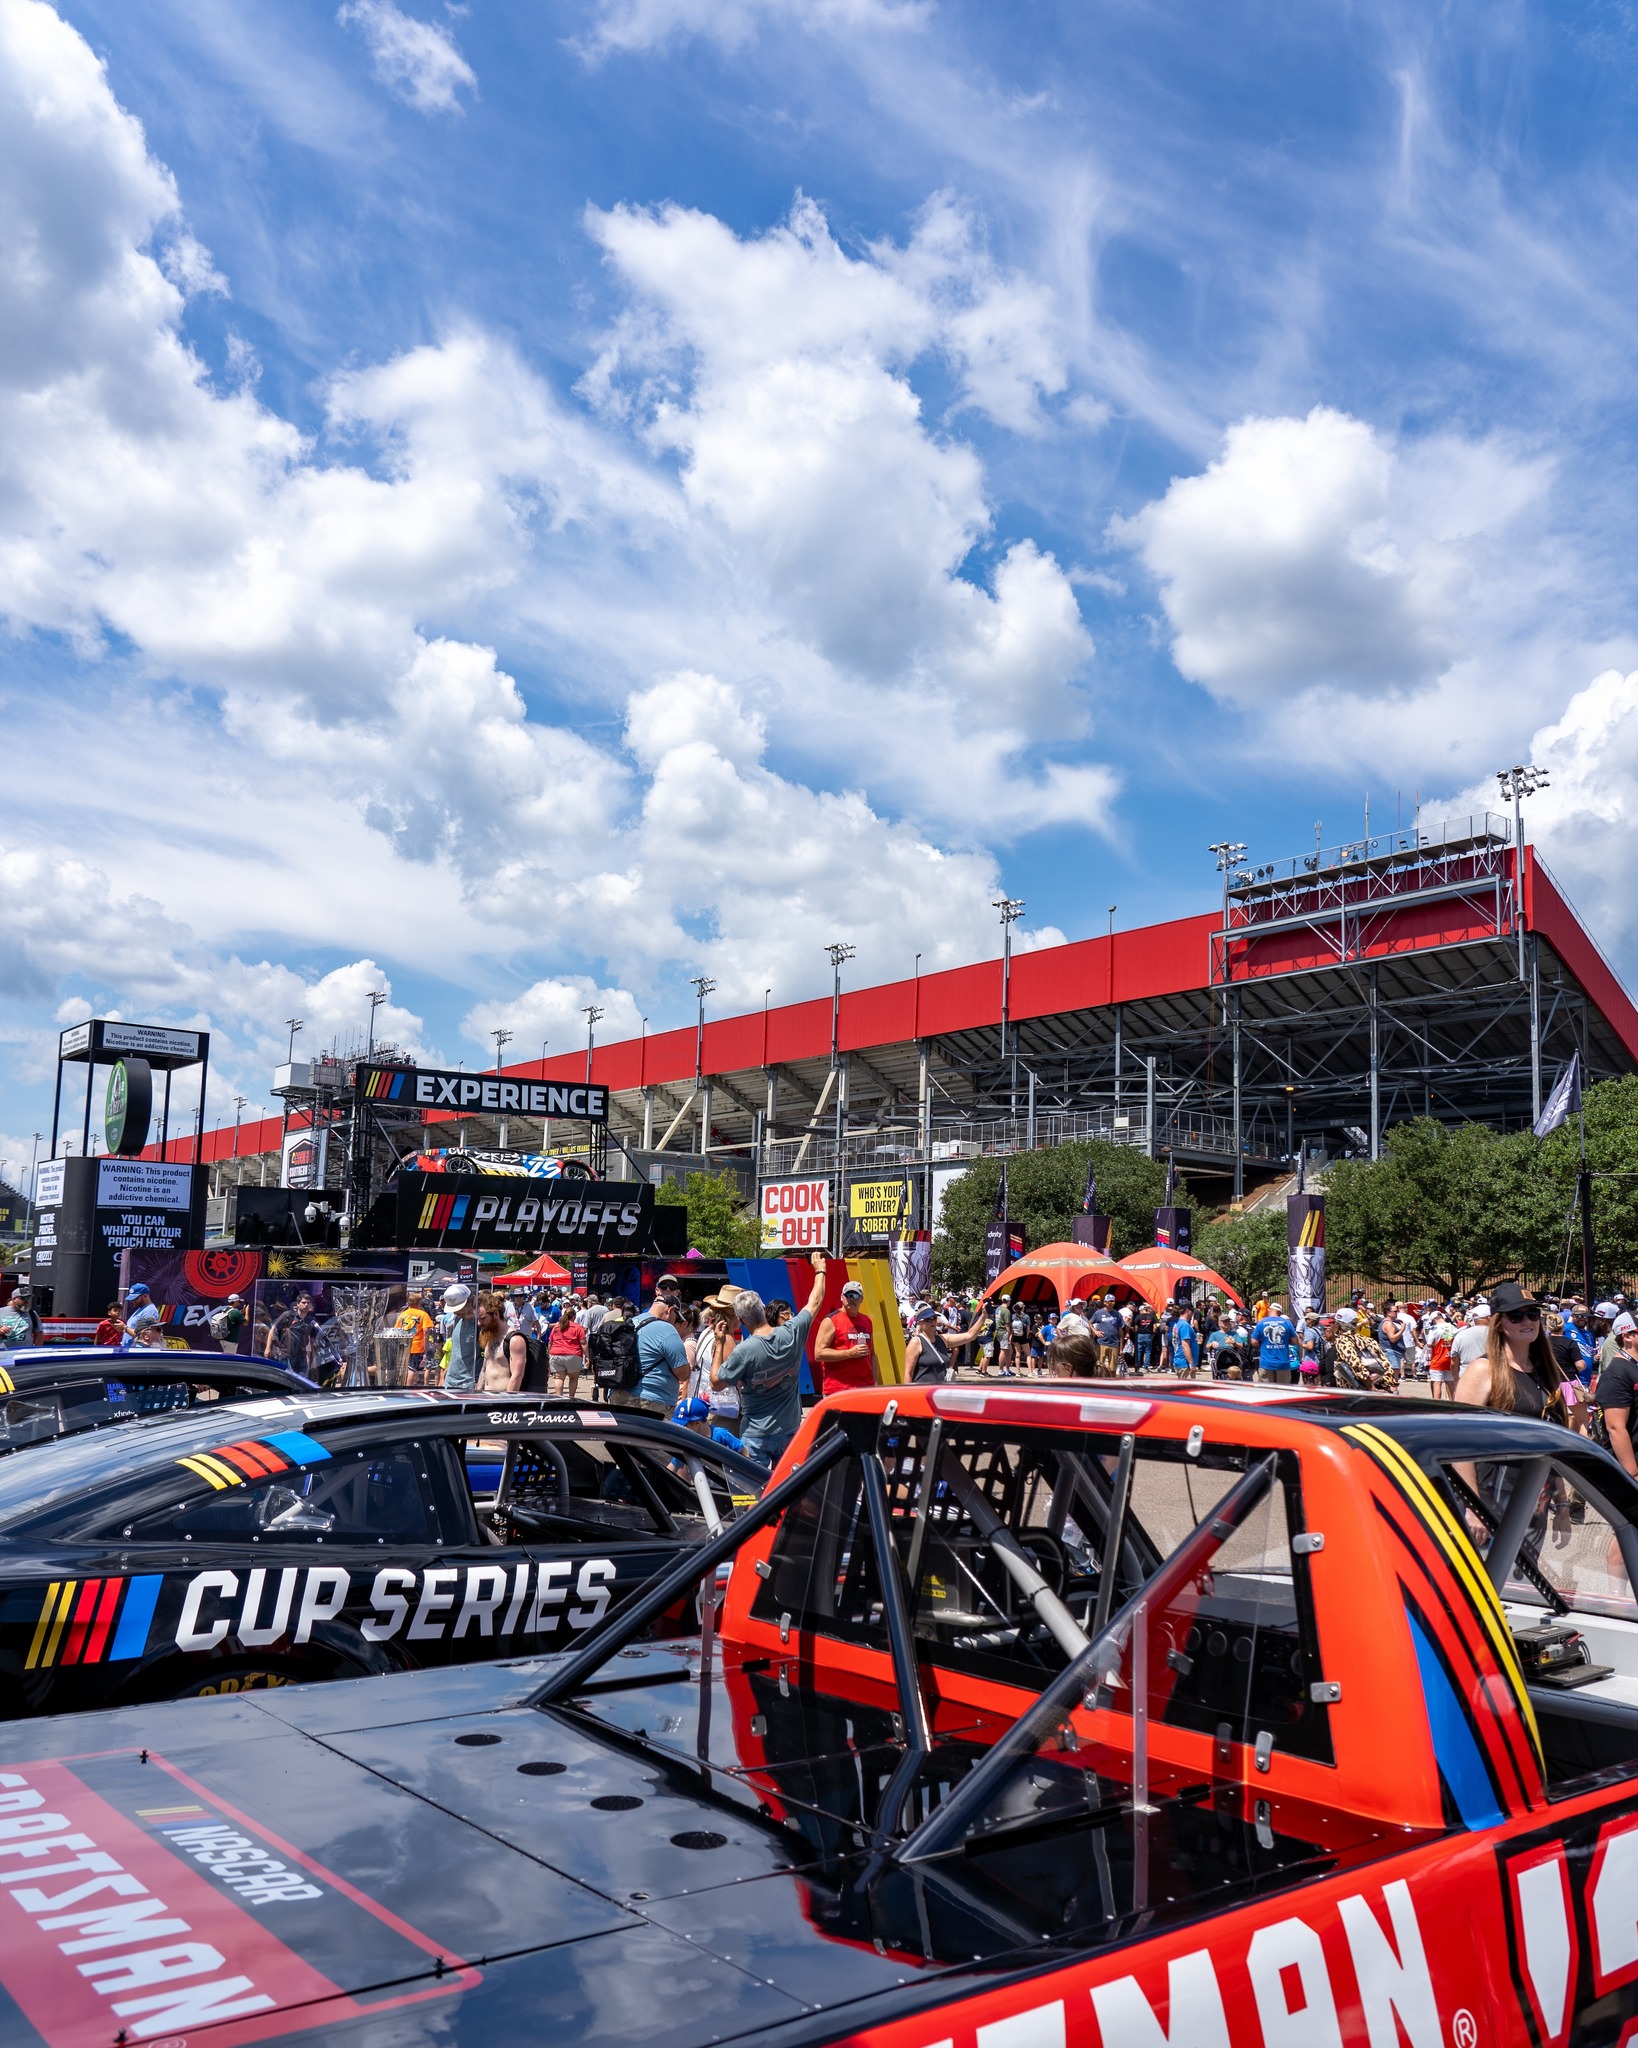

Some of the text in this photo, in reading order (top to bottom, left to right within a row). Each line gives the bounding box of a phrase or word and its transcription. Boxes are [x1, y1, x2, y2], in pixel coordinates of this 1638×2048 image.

[123, 1034, 144, 1042] product
[169, 1039, 192, 1047] nicotine.
[137, 1029, 167, 1038] WARNING:
[106, 1038, 129, 1046] Nicotine
[144, 1043, 171, 1051] addictive
[170, 1045, 196, 1053] chemical.
[416, 1075, 604, 1116] EXPERIENCE
[102, 1164, 190, 1178] WARNING: This product
[113, 1175, 178, 1185] contains nicotine.
[120, 1184, 152, 1192] Nicotine
[858, 1186, 882, 1200] WHO'S
[108, 1193, 180, 1203] addictive chemical.
[764, 1183, 825, 1214] COOK
[865, 1200, 896, 1213] DRIVER?
[121, 1214, 165, 1226] YOU CAN
[471, 1195, 642, 1236] PLAYOFFS
[102, 1225, 182, 1237] WHIP OUT YOUR
[781, 1216, 825, 1246] OUT
[854, 1217, 907, 1233] A SOBER OE
[108, 1237, 175, 1249] POUCH HERE.
[183, 1305, 229, 1327] EX
[113, 1410, 136, 1418] xfinity
[487, 1411, 576, 1426] Bill France
[175, 1559, 617, 1652] CUP SERIES
[161, 1825, 324, 1905] NASCAR
[0, 1773, 277, 2038] AFTSMAN
